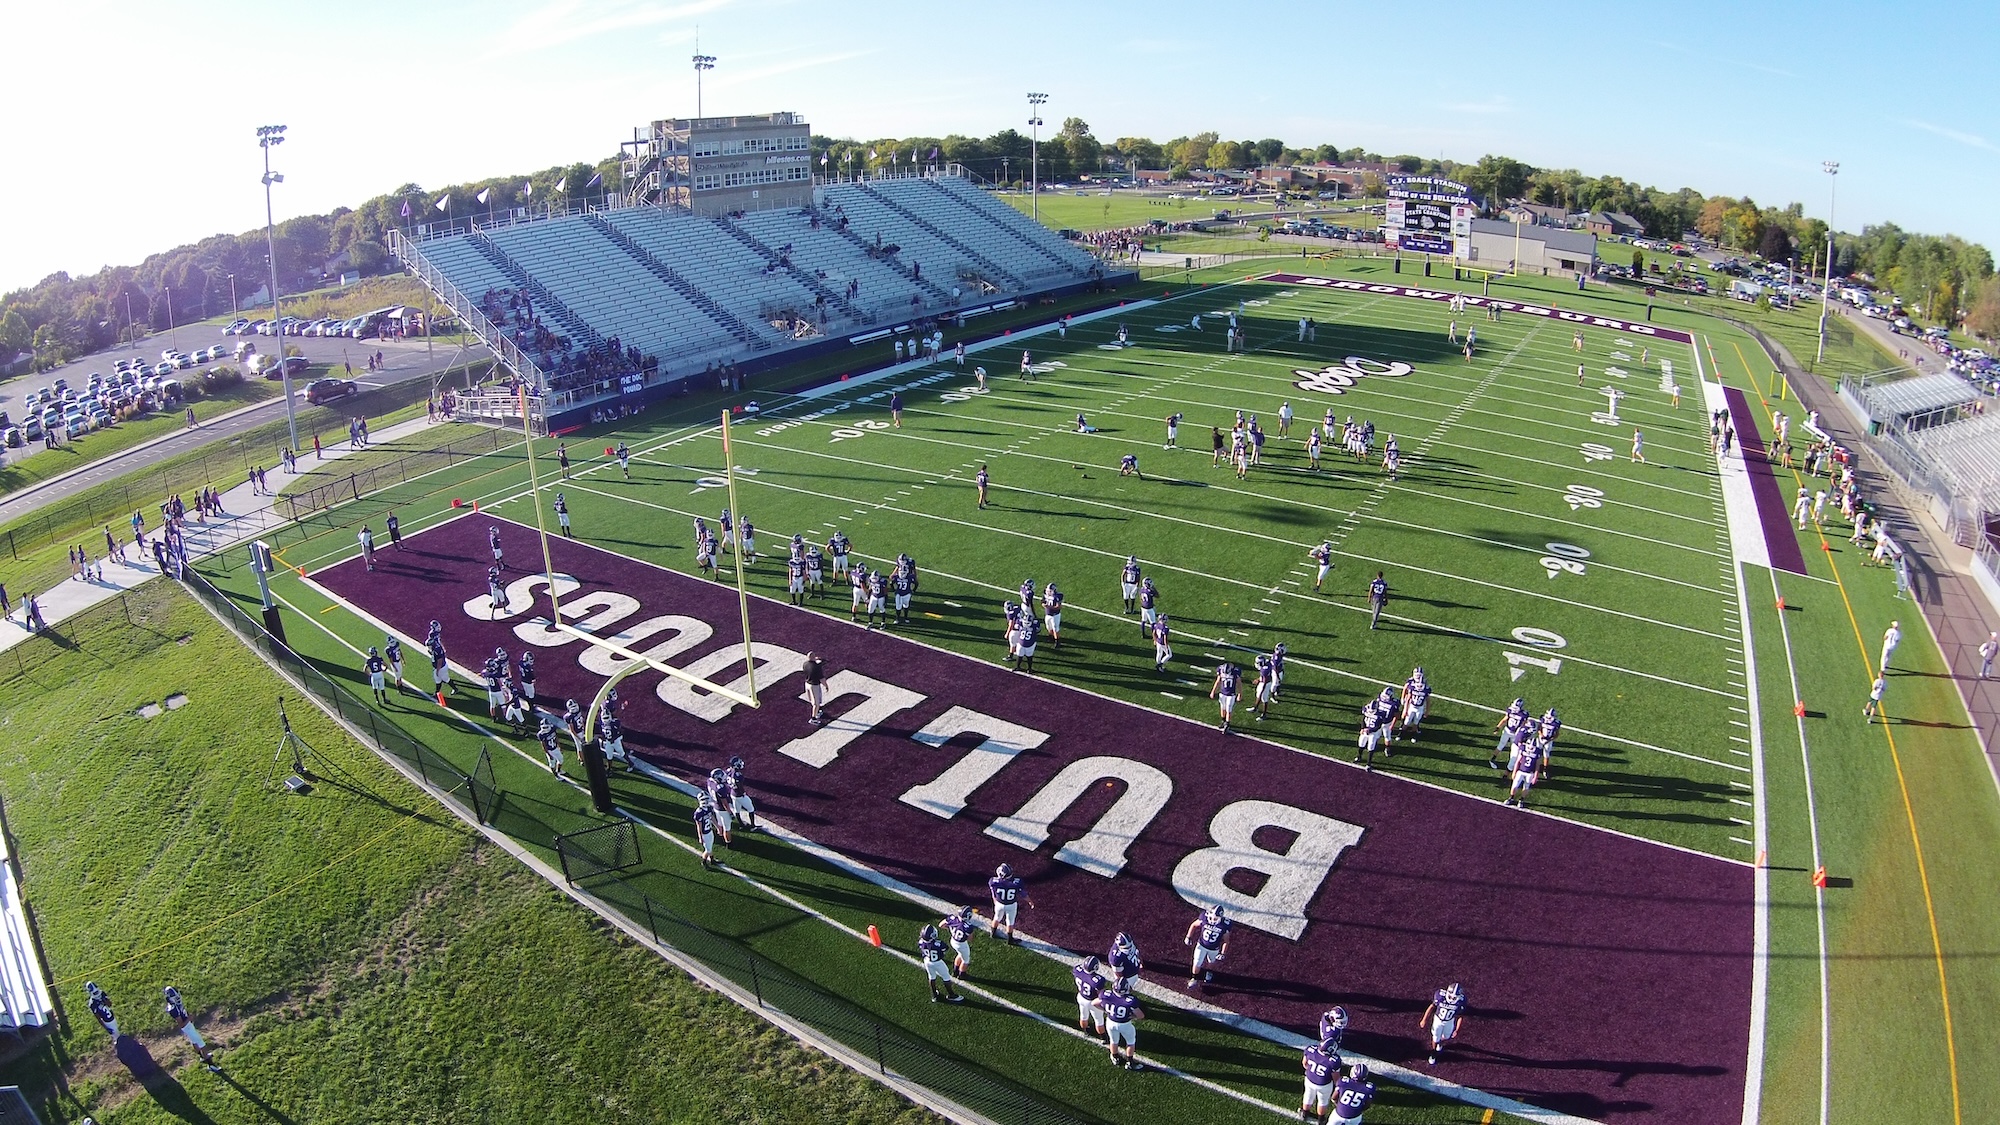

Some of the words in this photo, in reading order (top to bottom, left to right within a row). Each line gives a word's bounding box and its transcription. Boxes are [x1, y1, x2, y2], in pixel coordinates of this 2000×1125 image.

[1407, 176, 1432, 184] ROARK
[1434, 178, 1467, 192] STADIUM
[1389, 190, 1409, 198] HOME
[1433, 194, 1469, 205] BULLDOGS
[1563, 484, 1605, 509] 30
[1539, 542, 1591, 576] 20
[897, 582, 908, 591] 73
[1502, 626, 1567, 675] 10
[372, 662, 379, 671] 5
[462, 571, 1368, 940] BULLDOGS
[1524, 756, 1532, 767] 3
[996, 888, 1018, 901] 76
[1202, 929, 1220, 943] 63
[104, 1006, 114, 1020] 3
[1104, 1003, 1127, 1018] 49
[1438, 1008, 1456, 1020] 90
[1307, 1060, 1328, 1077] 75
[1340, 1090, 1366, 1107] 65
